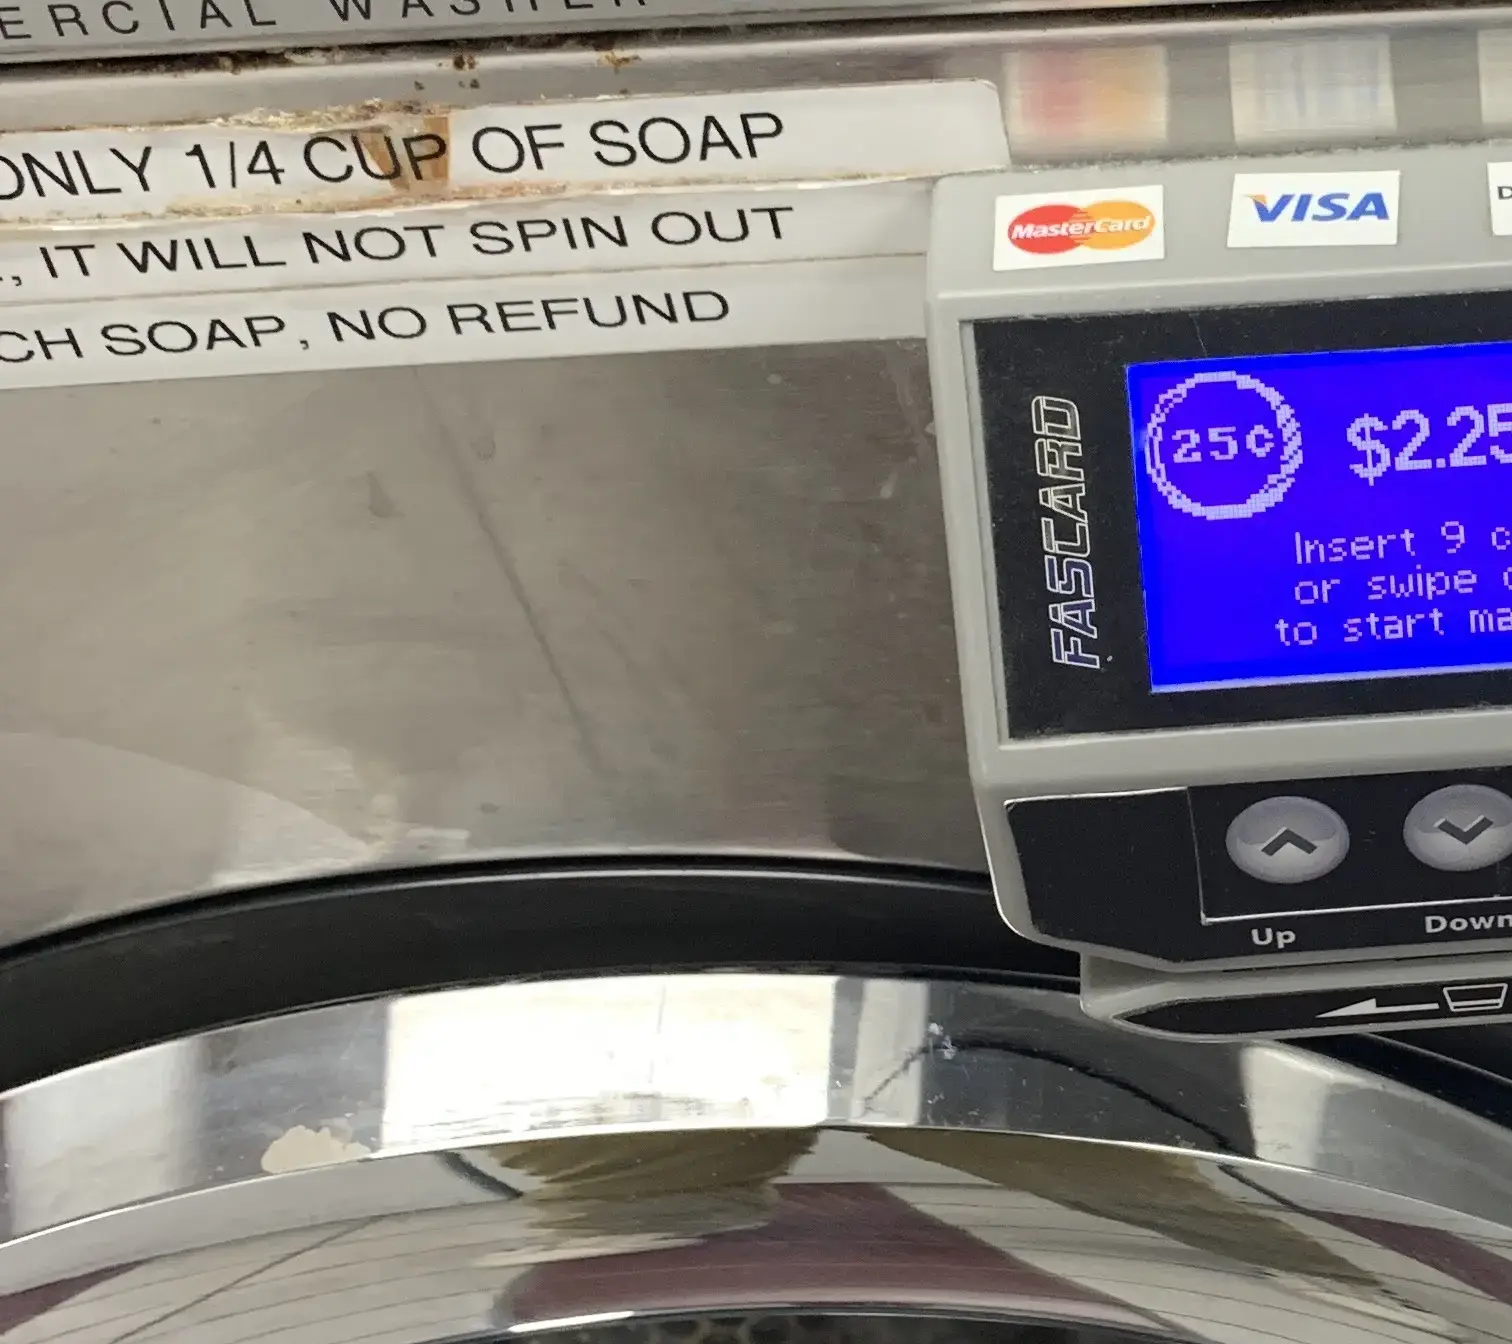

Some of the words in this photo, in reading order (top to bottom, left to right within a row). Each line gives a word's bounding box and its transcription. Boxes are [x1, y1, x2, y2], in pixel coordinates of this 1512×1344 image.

[185, 139, 286, 189] 1/4
[303, 131, 448, 184] CUP
[471, 123, 567, 174] OF
[588, 111, 786, 168] SOAP
[1010, 215, 1151, 240] MasterCard
[1243, 192, 1389, 223] VISA
[39, 243, 96, 279] IT
[116, 234, 287, 276] WILL
[301, 223, 447, 266] NOT
[470, 215, 629, 256] SPIN
[650, 207, 795, 246] OUT
[100, 313, 311, 359] SOAP,
[327, 307, 428, 344] NO
[446, 290, 731, 336] REFUND
[1029, 395, 1102, 669] FASCARD
[1293, 529, 1417, 566] Insert
[1440, 522, 1468, 553] 9
[1293, 575, 1334, 607] or
[1367, 565, 1478, 602] swipe
[1276, 615, 1318, 648] to
[1342, 607, 1446, 643] start
[1251, 926, 1296, 952] Up
